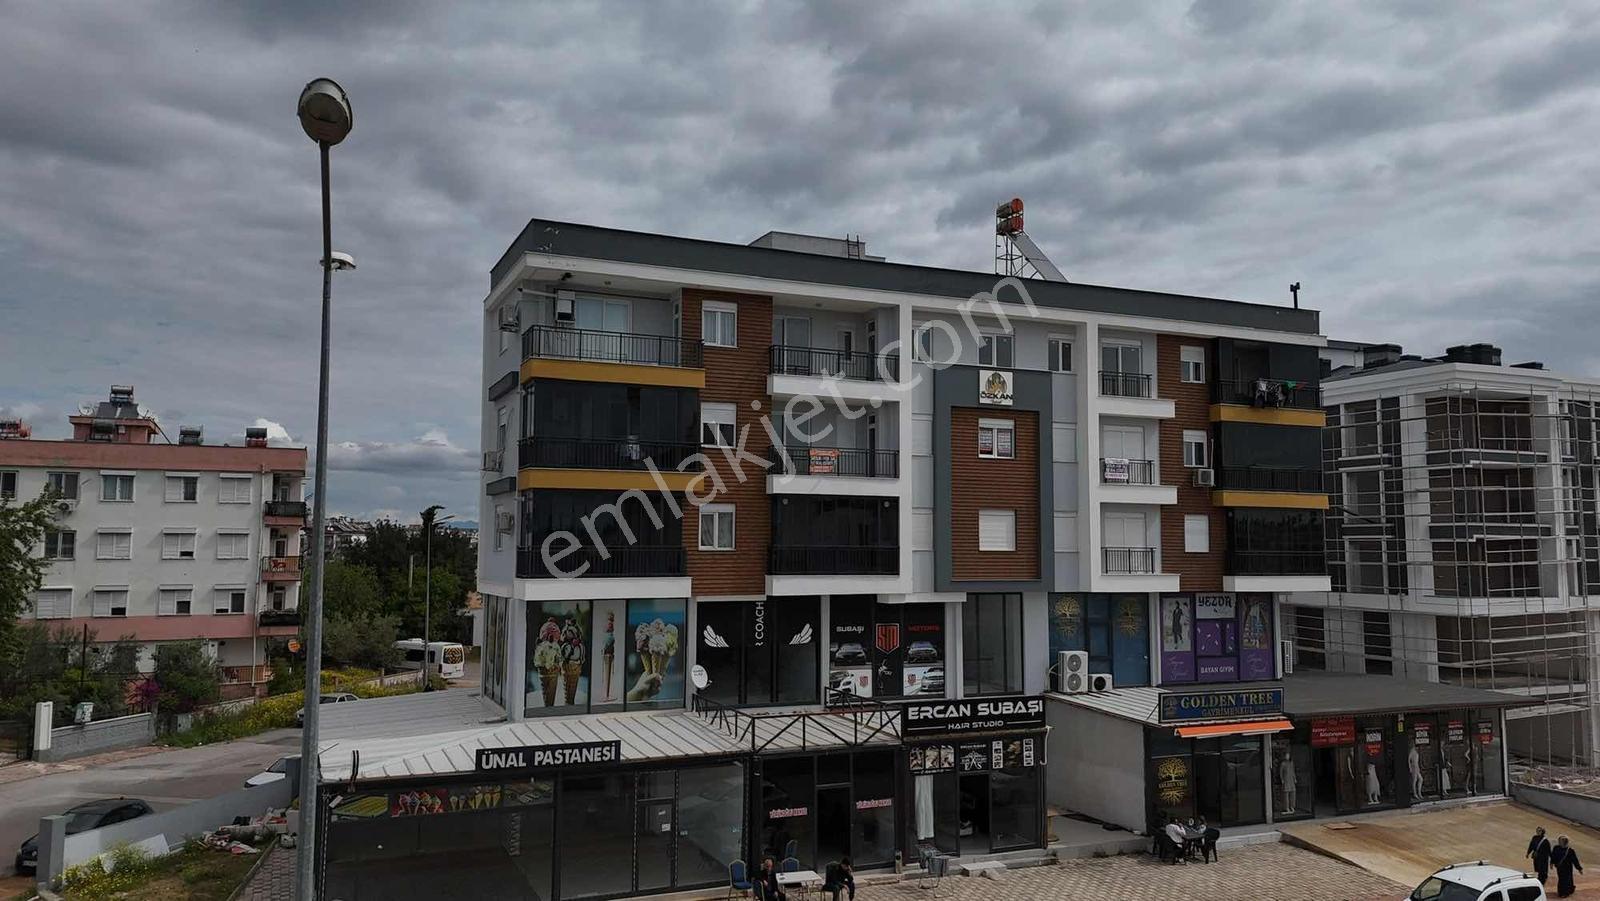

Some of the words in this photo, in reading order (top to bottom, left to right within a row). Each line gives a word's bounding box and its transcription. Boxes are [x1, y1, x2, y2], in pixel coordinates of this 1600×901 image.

[755, 602, 764, 640] COACH
[908, 704, 970, 720] ERCAN
[977, 700, 1042, 716] SUBAŞI
[1180, 695, 1236, 709] GOLDEN
[1240, 692, 1273, 705] TREE
[972, 720, 1003, 728] STUDIO
[482, 751, 526, 769] ÜNAL
[534, 743, 616, 766] PASTANESİ
